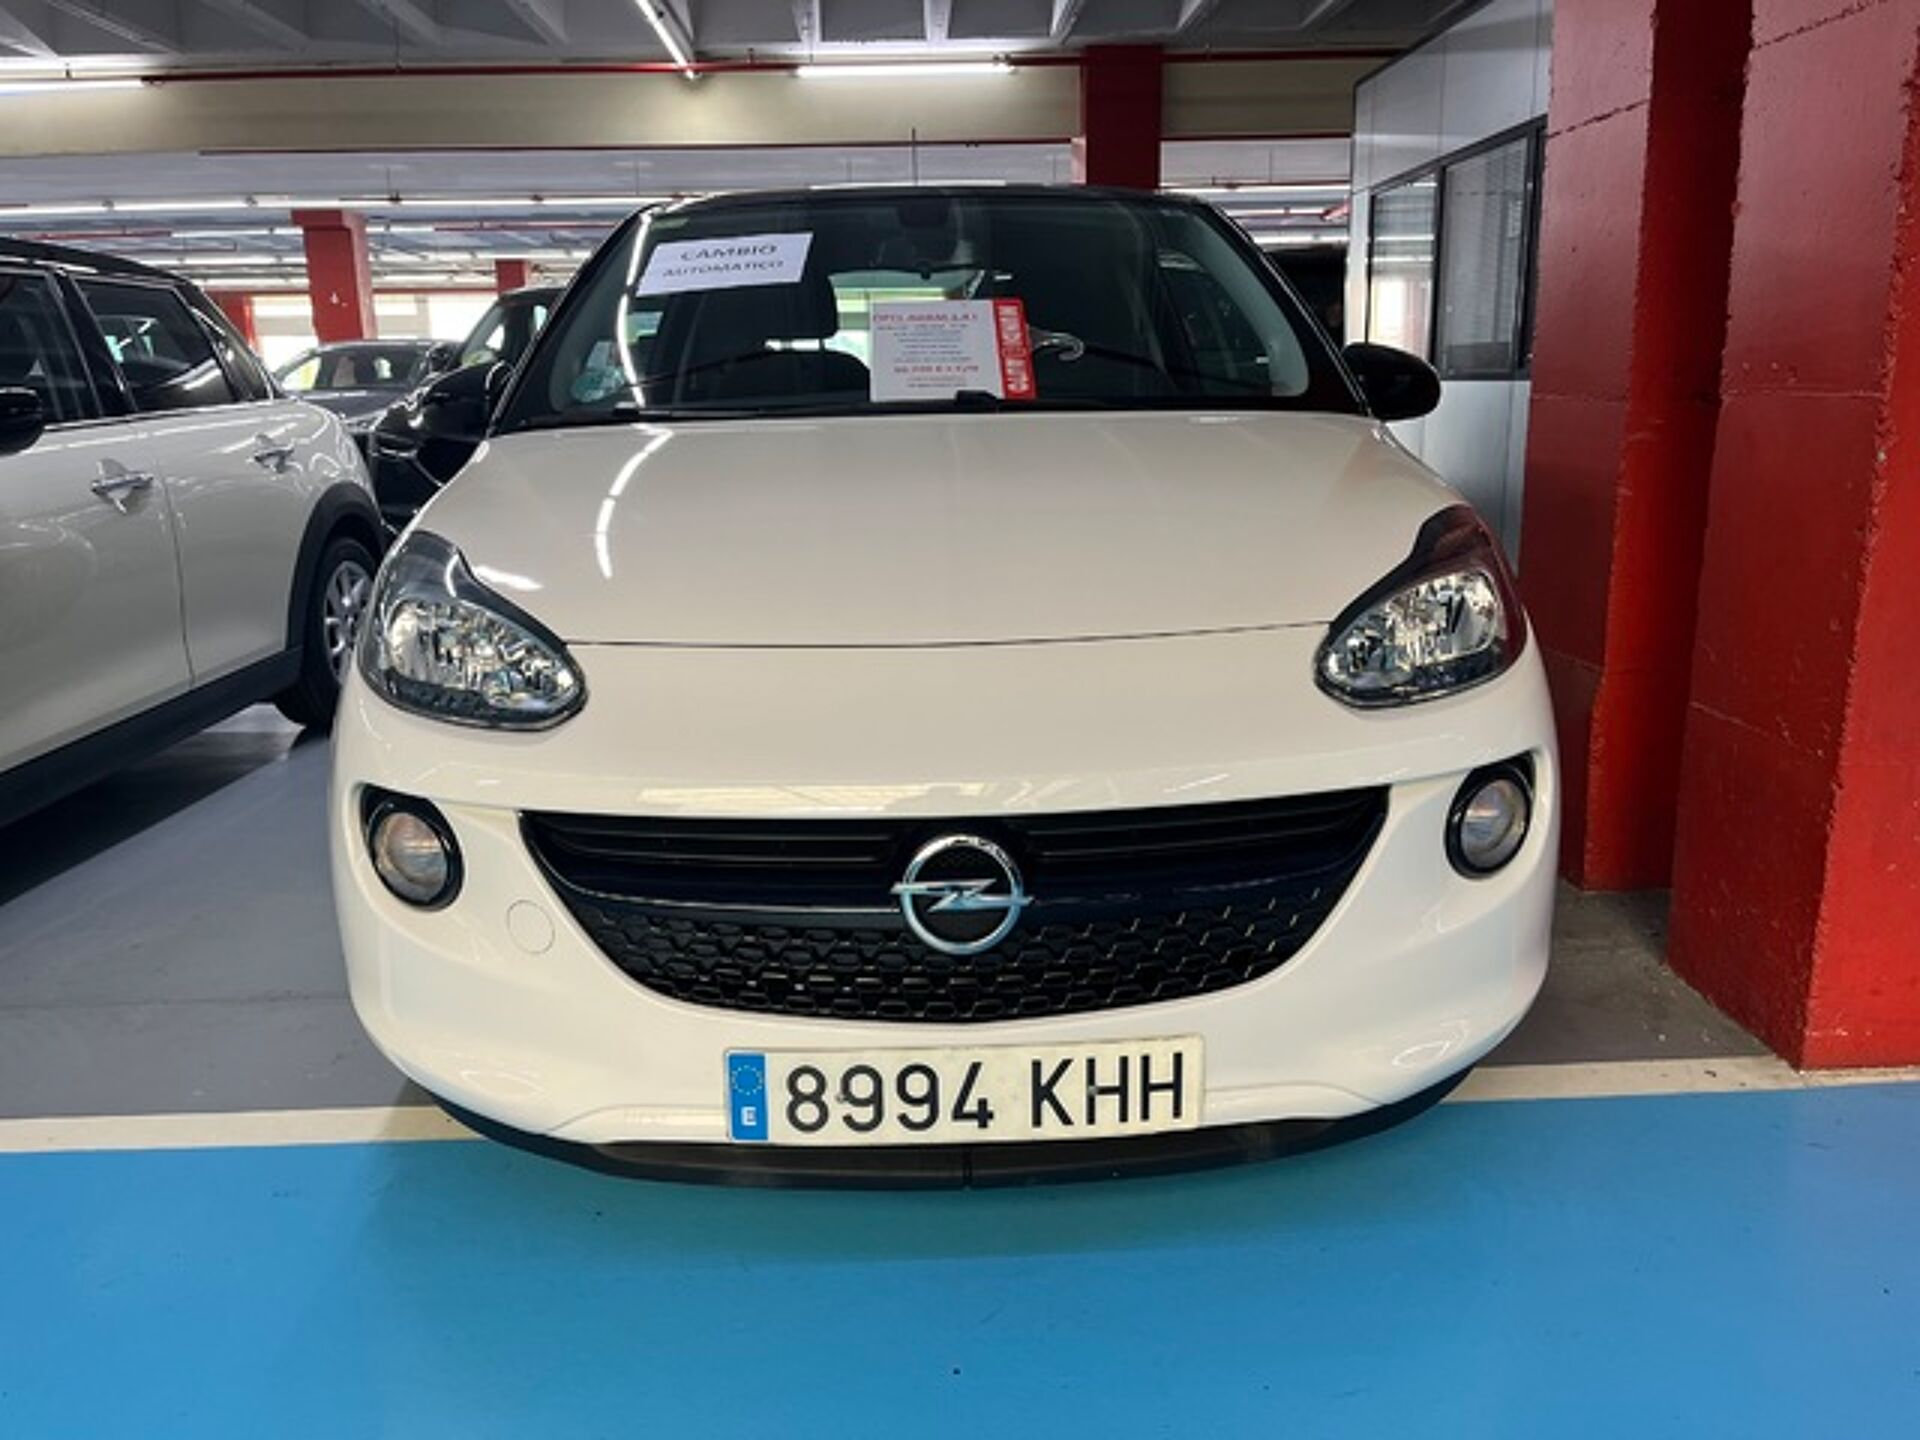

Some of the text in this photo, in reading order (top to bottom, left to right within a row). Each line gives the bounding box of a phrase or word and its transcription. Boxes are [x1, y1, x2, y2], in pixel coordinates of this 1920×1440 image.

[680, 244, 778, 261] CAMBIO
[786, 1052, 1183, 1133] 8994 KHH
[740, 1106, 758, 1126] E
